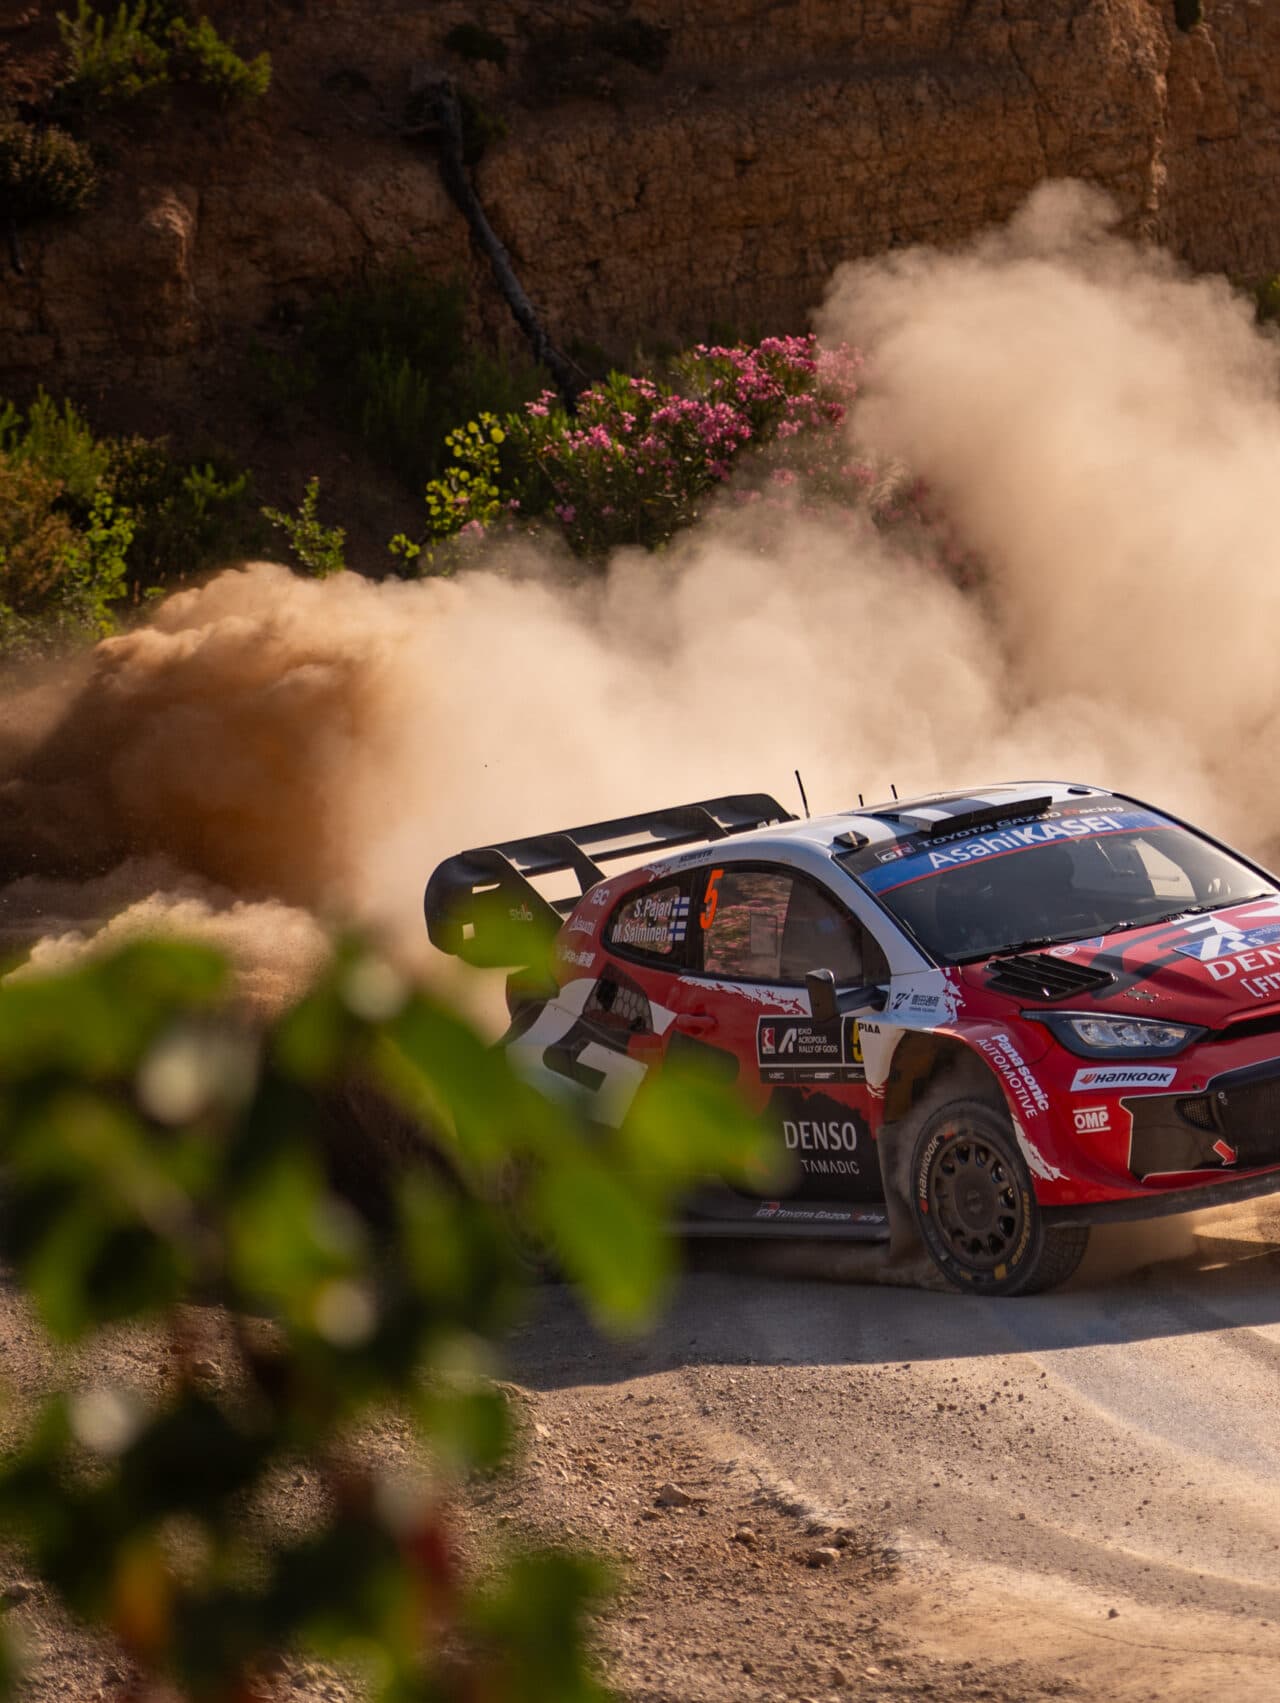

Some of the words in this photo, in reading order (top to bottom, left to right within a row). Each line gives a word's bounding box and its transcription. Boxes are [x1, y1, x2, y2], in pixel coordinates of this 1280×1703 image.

[917, 824, 994, 848] TOYOTA
[700, 868, 725, 929] 5
[857, 1022, 882, 1035] PIAA
[814, 1045, 823, 1053] OF
[823, 1045, 839, 1054] GODS
[976, 1038, 1039, 1119] AUTOMOTIVE
[991, 1033, 1050, 1111] Panasonic
[1073, 1111, 1109, 1129] OMP
[782, 1120, 858, 1151] DENSO
[800, 1159, 860, 1174] TAMADIC
